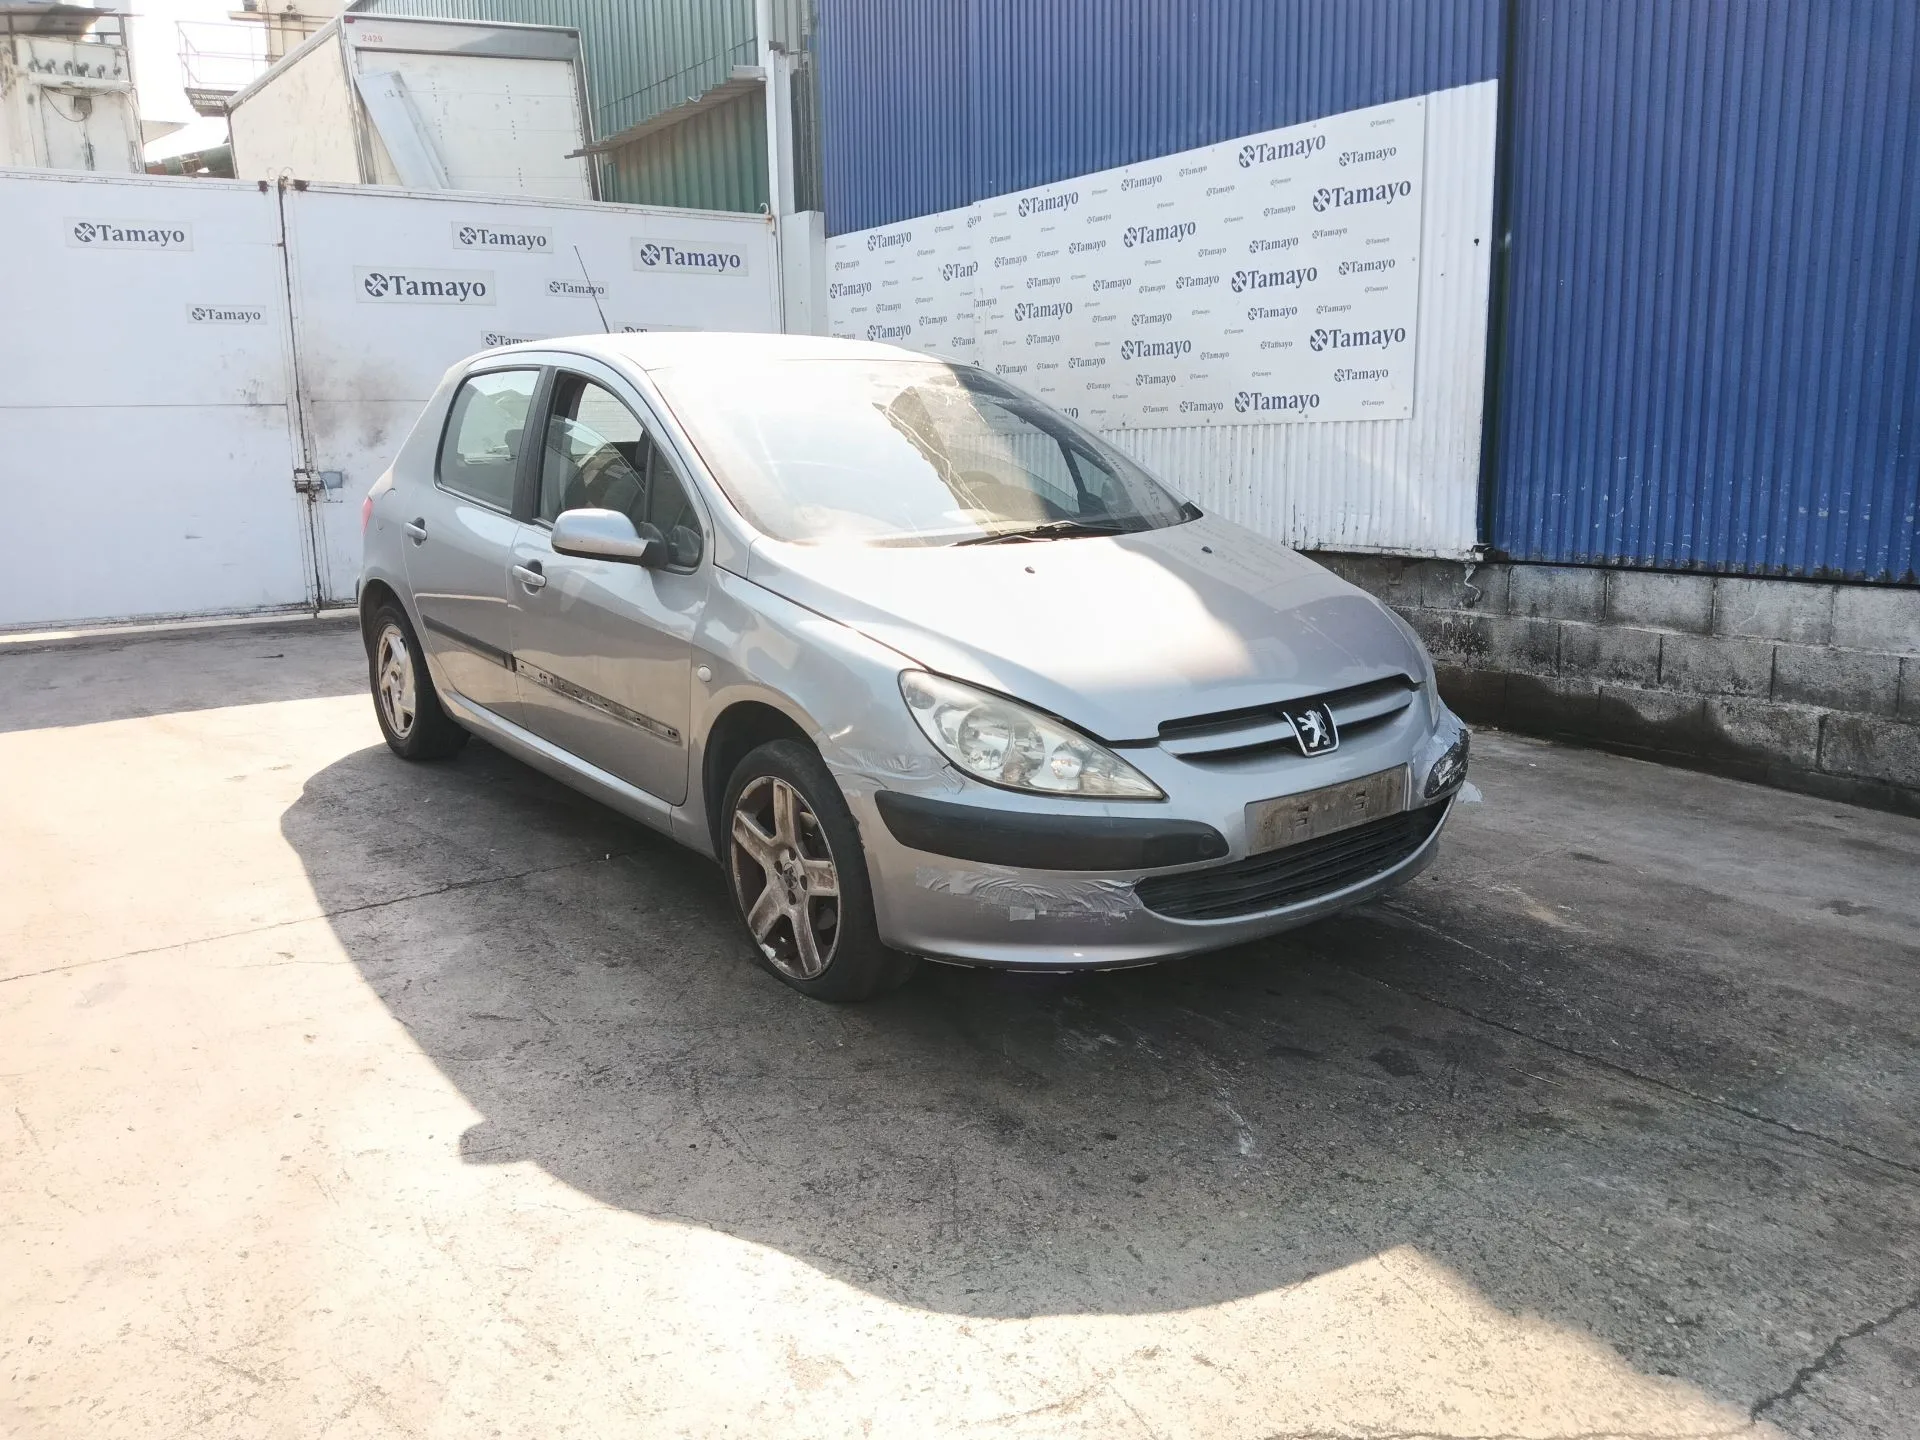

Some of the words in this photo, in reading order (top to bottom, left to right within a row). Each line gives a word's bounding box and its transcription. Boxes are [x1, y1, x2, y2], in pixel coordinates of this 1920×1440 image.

[1256, 134, 1326, 163] Tamayo
[1351, 147, 1397, 164] Tamayo
[1184, 165, 1207, 176] Tamayo
[1129, 174, 1162, 189] Tamayo
[1212, 184, 1235, 195] Tamayo
[1332, 180, 1412, 208] Tamayo
[1030, 192, 1079, 214] Tamayo
[1270, 205, 1296, 216] Tamayo
[97, 224, 185, 246] Tamayo
[477, 229, 547, 250] Tamayo
[1138, 221, 1196, 244] Tamayo
[1319, 227, 1348, 238] Tamayo
[877, 231, 912, 249] Tamayo
[1076, 240, 1107, 253] Tamayo
[1259, 237, 1299, 252] Tamayo
[661, 246, 741, 272] Tamayo
[1204, 247, 1227, 257] Tamayo
[1001, 255, 1028, 267] Tamayo
[1350, 258, 1396, 273] Tamayo
[1033, 276, 1061, 288] Tamayo
[1101, 278, 1132, 290] Tamayo
[1185, 275, 1220, 288] Tamayo
[1248, 266, 1318, 289] Tamayo
[389, 275, 486, 302] Tamayo
[560, 282, 605, 296] Tamayo
[837, 281, 872, 297] Tamayo
[1144, 284, 1166, 293] Tamayo
[880, 303, 901, 313] Tamayo
[1026, 301, 1073, 320] Tamayo
[1258, 306, 1298, 319] Tamayo
[1323, 304, 1351, 313] Tamayo
[206, 309, 261, 323] Tamayo
[925, 315, 948, 326] Tamayo
[1140, 312, 1172, 325] Tamayo
[876, 324, 912, 341] Tamayo
[1033, 334, 1060, 344] Tamayo
[1329, 327, 1406, 350] Tamayo
[1135, 340, 1192, 359] Tamayo
[1206, 351, 1229, 361] Tamayo
[1002, 364, 1028, 375] Tamayo
[1076, 357, 1106, 369] Tamayo
[1143, 374, 1177, 386] Tamayo
[1345, 368, 1389, 382] Tamayo
[1188, 401, 1224, 414] Tamayo
[1251, 392, 1320, 415] Tamayo
